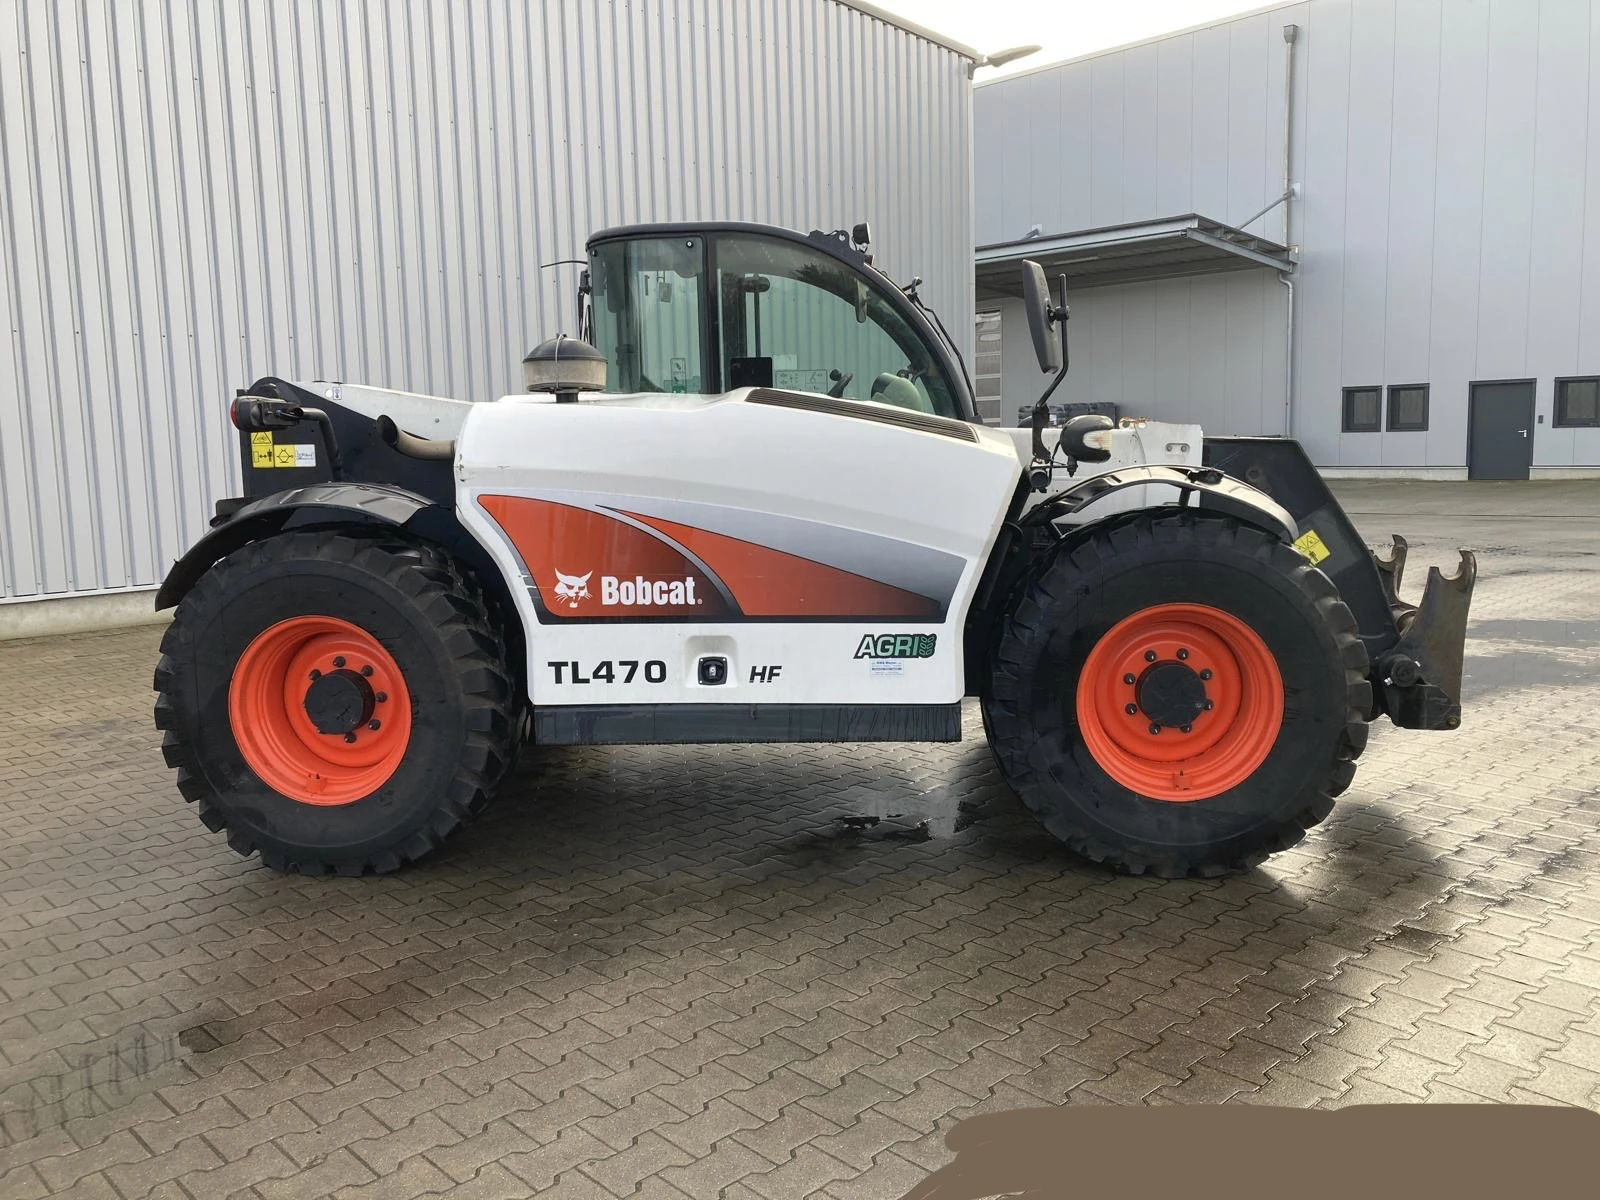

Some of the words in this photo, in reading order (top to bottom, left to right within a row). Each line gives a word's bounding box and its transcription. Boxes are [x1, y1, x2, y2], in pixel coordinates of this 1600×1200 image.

[854, 634, 920, 658] AGRI
[547, 660, 667, 684] TL470
[749, 665, 782, 683] HF
